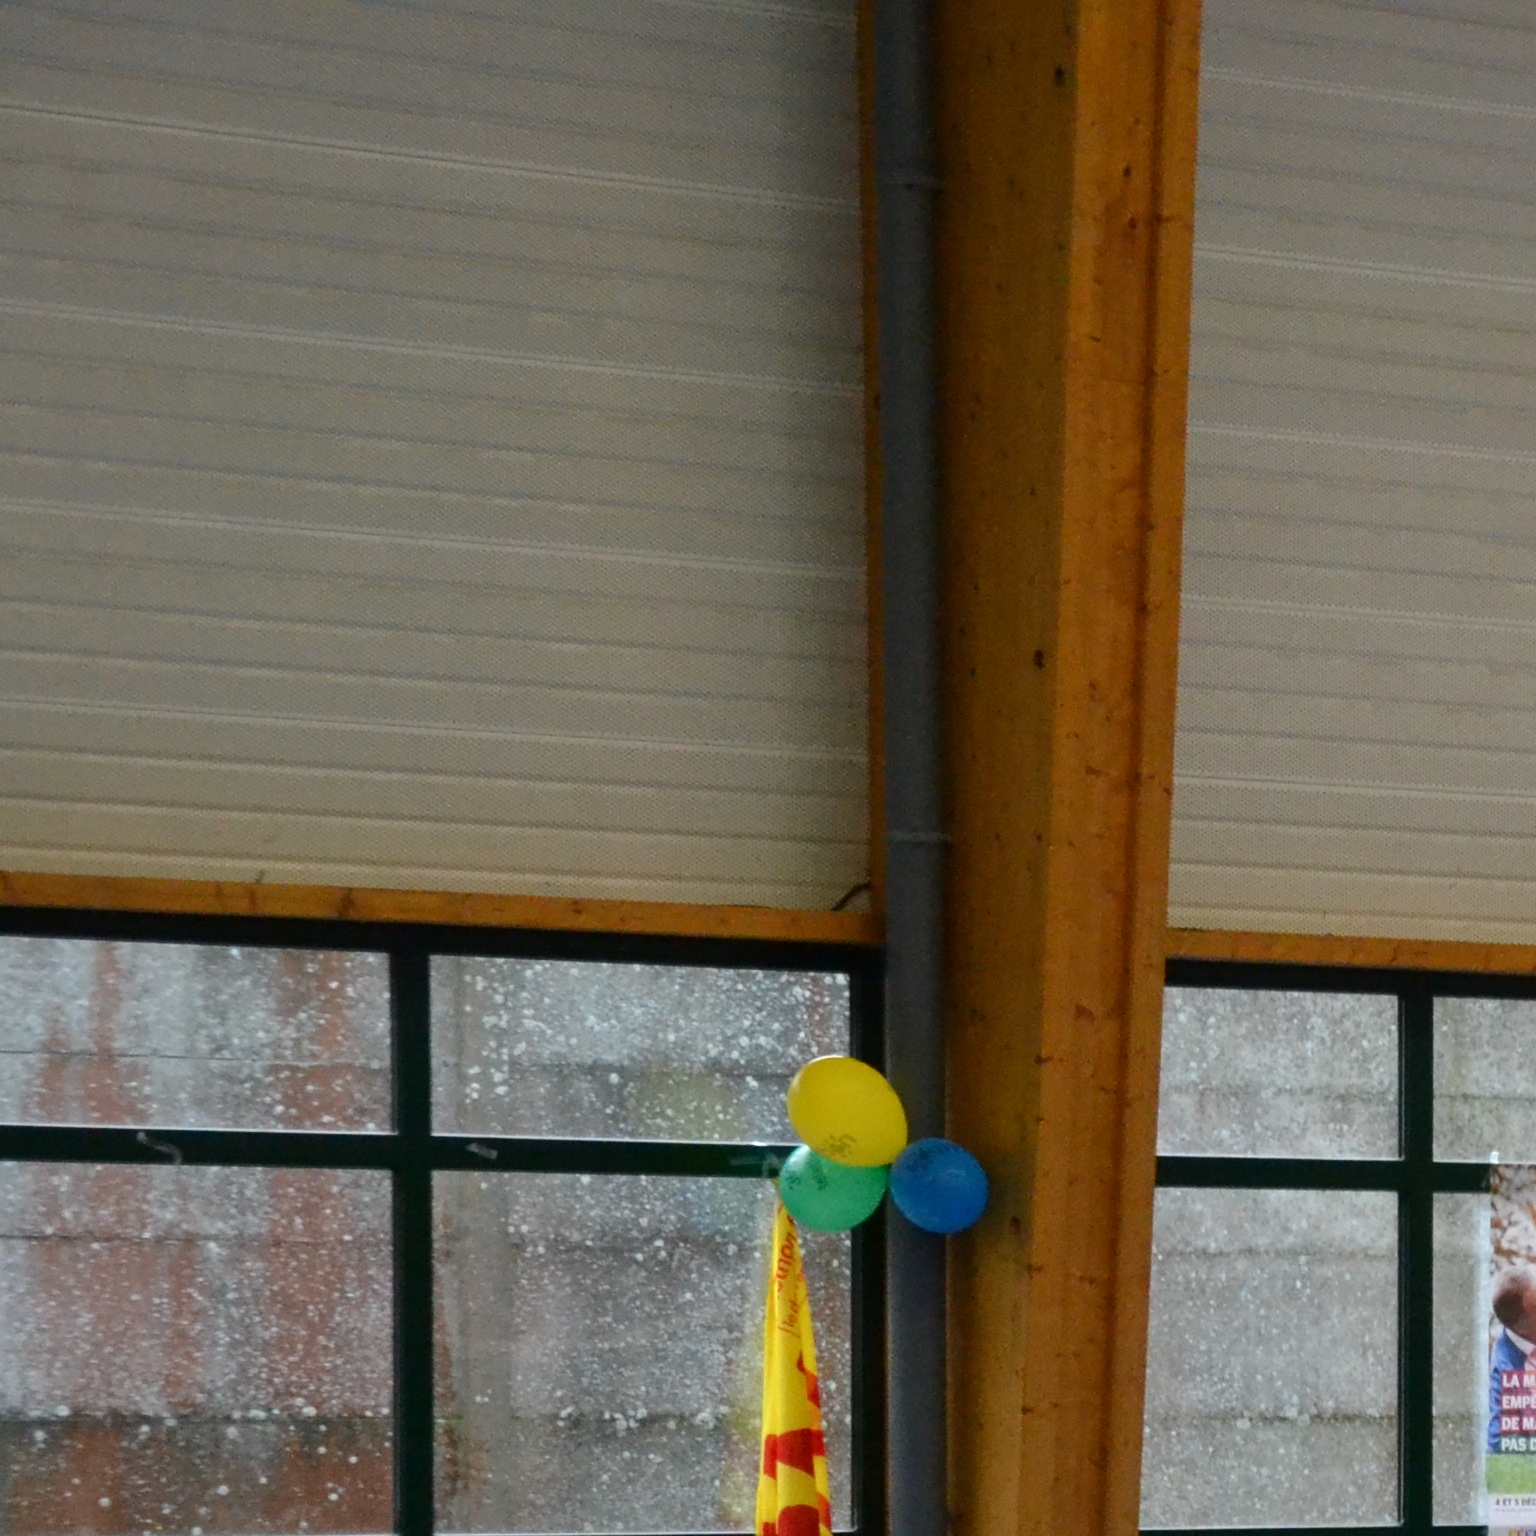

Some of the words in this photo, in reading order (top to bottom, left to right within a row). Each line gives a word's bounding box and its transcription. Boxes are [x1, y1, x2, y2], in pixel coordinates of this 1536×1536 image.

[1502, 1373, 1520, 1388] LA
[1502, 1416, 1520, 1430] DE
[1501, 1437, 1527, 1452] PAS
